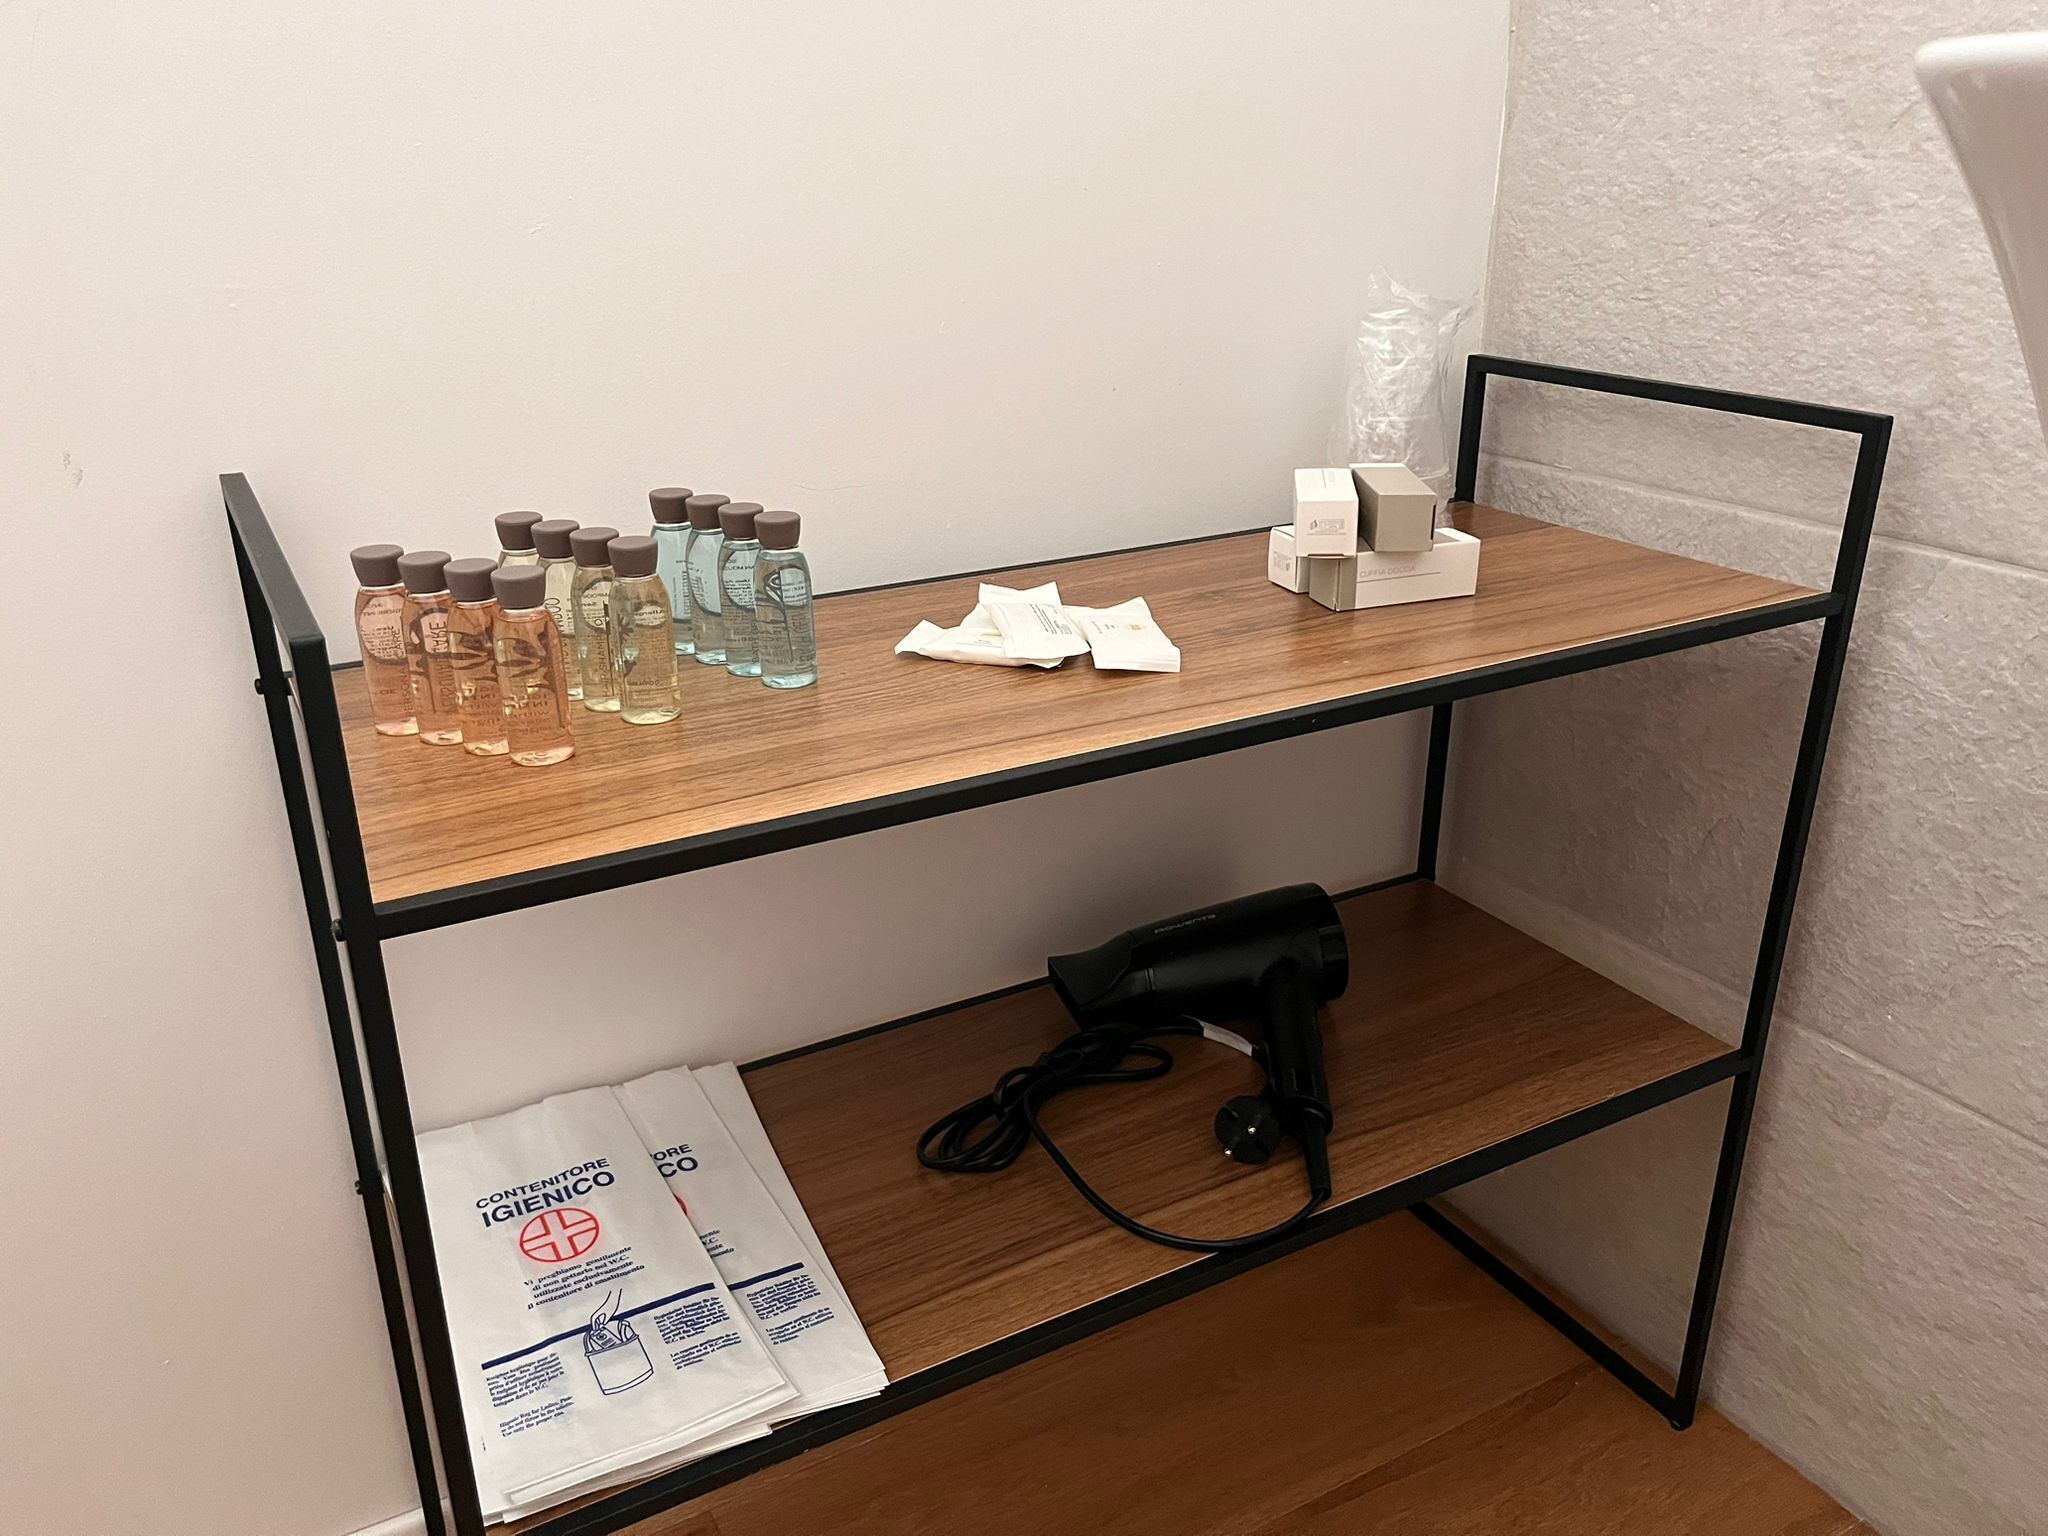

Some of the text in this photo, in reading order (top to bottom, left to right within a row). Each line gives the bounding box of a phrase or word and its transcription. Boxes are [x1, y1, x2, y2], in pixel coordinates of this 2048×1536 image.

[476, 1158, 610, 1209] CONTENITORE
[482, 1171, 615, 1228] IGIENICO
[523, 1246, 632, 1287] Vi preghiamo gentilmente
[532, 1283, 541, 1292] di
[543, 1279, 560, 1288] non
[595, 1262, 608, 1271] nel
[609, 1254, 630, 1267] W.C.
[534, 1260, 634, 1300] utilizzate esclusivamente
[536, 1286, 583, 1307] contenitore
[585, 1281, 593, 1289] di
[595, 1265, 645, 1286] smaltimento
